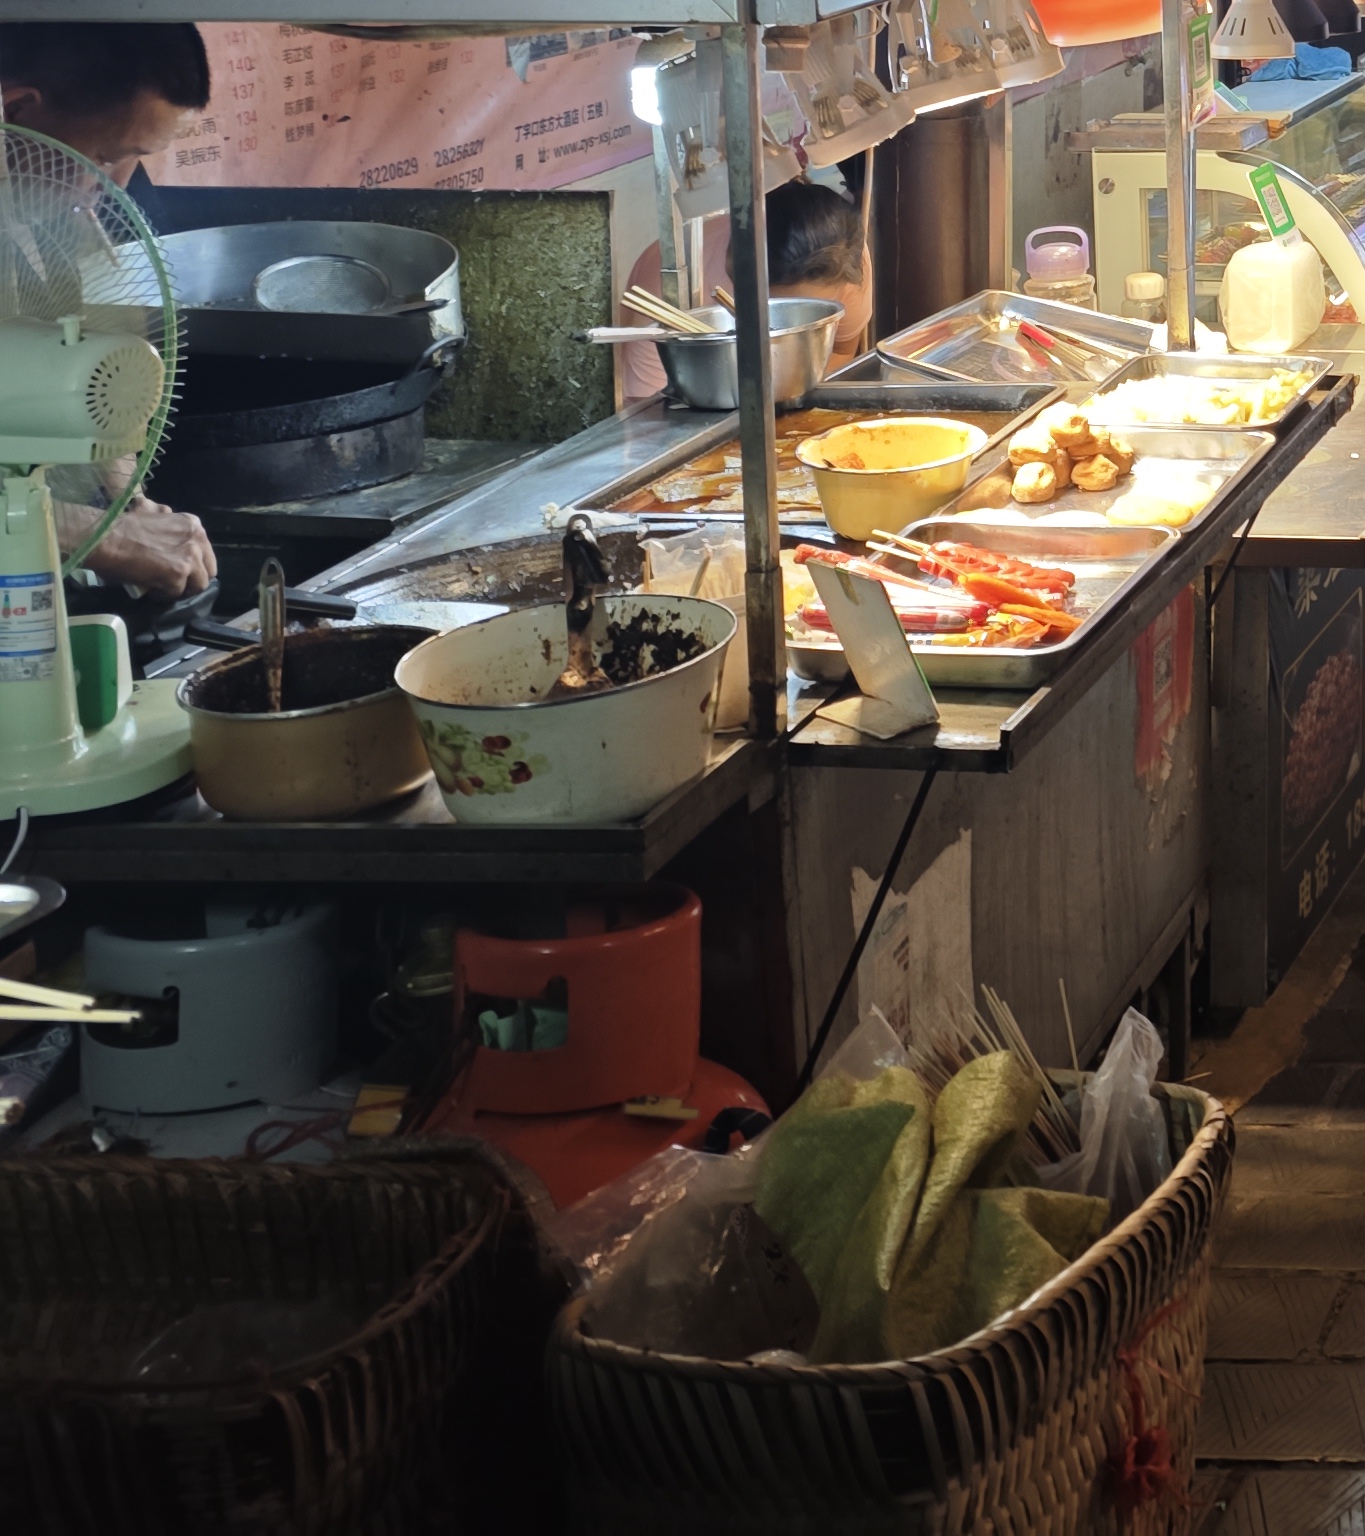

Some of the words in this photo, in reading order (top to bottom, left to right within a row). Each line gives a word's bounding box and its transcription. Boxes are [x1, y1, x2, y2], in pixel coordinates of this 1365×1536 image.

[176, 145, 222, 169] 吴振东
[434, 138, 485, 169] 28256321
[359, 157, 419, 189] 28220629
